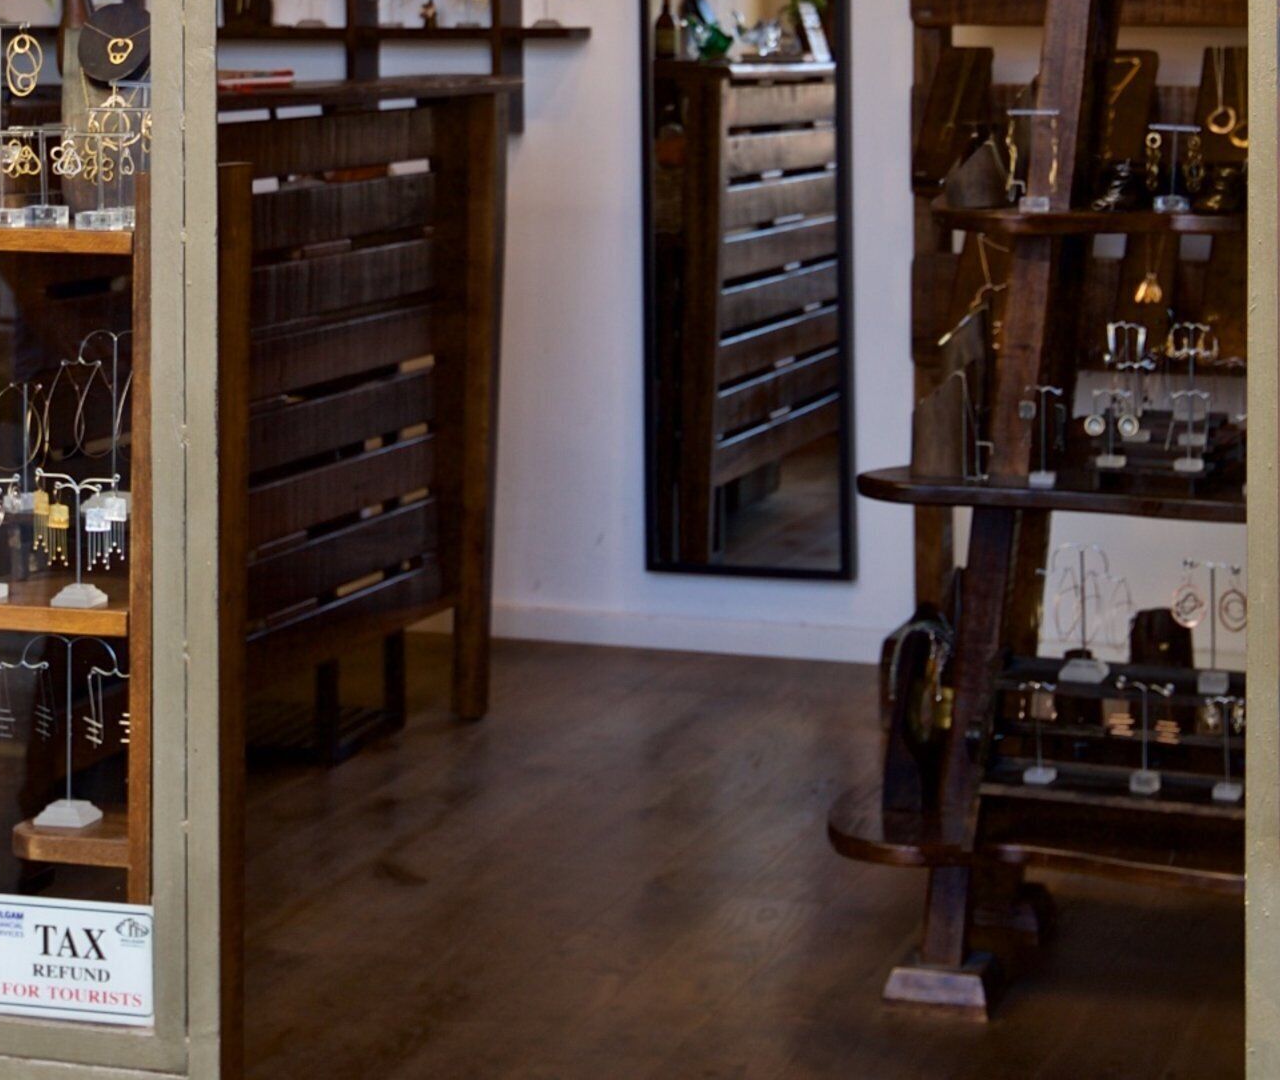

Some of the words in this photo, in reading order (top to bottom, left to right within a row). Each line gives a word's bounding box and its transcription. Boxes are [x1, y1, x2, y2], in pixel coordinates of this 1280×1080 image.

[34, 924, 106, 960] TAX
[32, 963, 111, 983] REFUND
[1, 982, 39, 999] FOR
[47, 985, 142, 1007] TOURISTS
